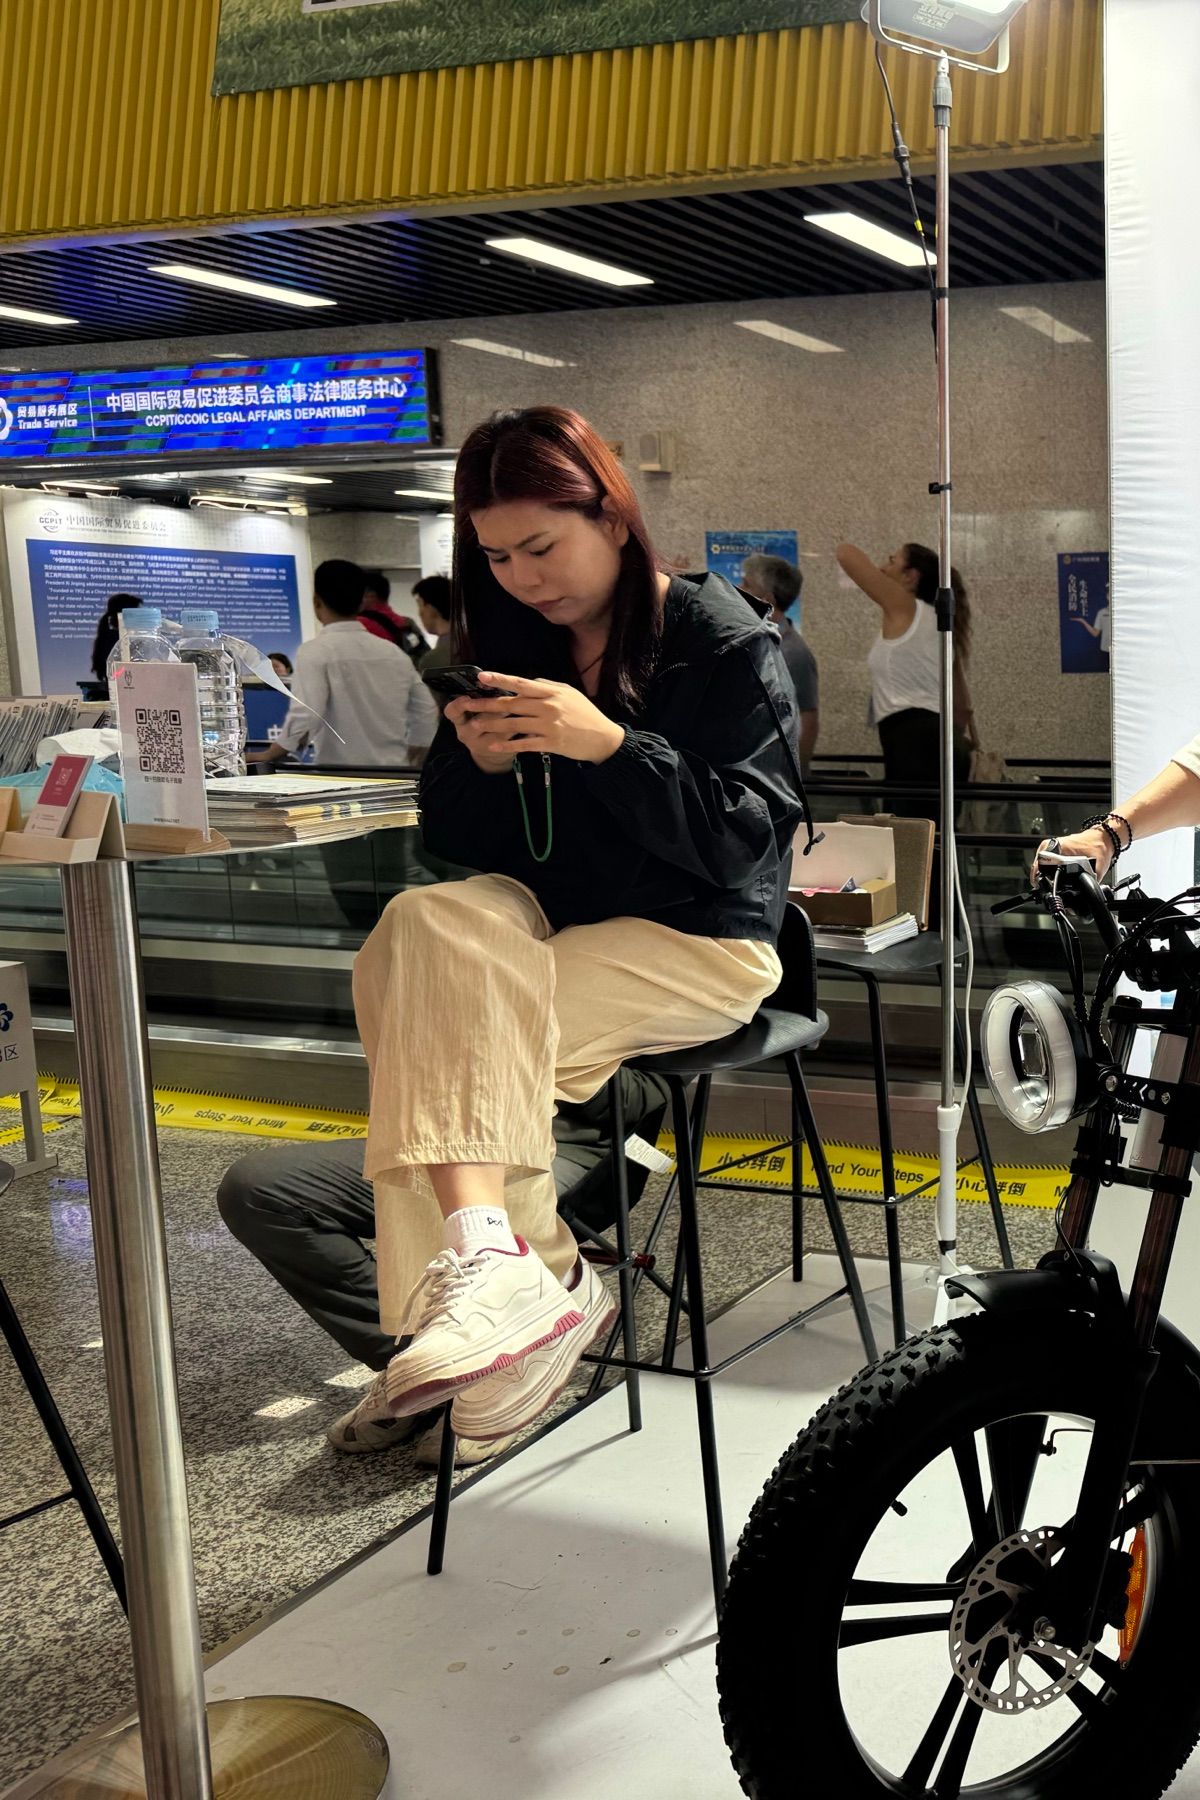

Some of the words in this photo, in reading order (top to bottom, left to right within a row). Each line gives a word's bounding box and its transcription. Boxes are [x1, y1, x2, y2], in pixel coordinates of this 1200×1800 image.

[106, 376, 407, 413] 中国国际贸易促进委员会商事法律服务中心
[17, 403, 78, 418] 贸易服务展区
[211, 410, 246, 424] LEGAL
[248, 408, 292, 422] AFFAIRS
[294, 405, 367, 420] DEPARTMENT
[18, 419, 42, 430] Trade
[44, 417, 78, 428] Service
[194, 1109, 225, 1122] Steps
[227, 1113, 255, 1125] Your
[256, 1118, 288, 1129] Mind
[850, 1163, 882, 1178] Your
[893, 1167, 924, 1184] teps
